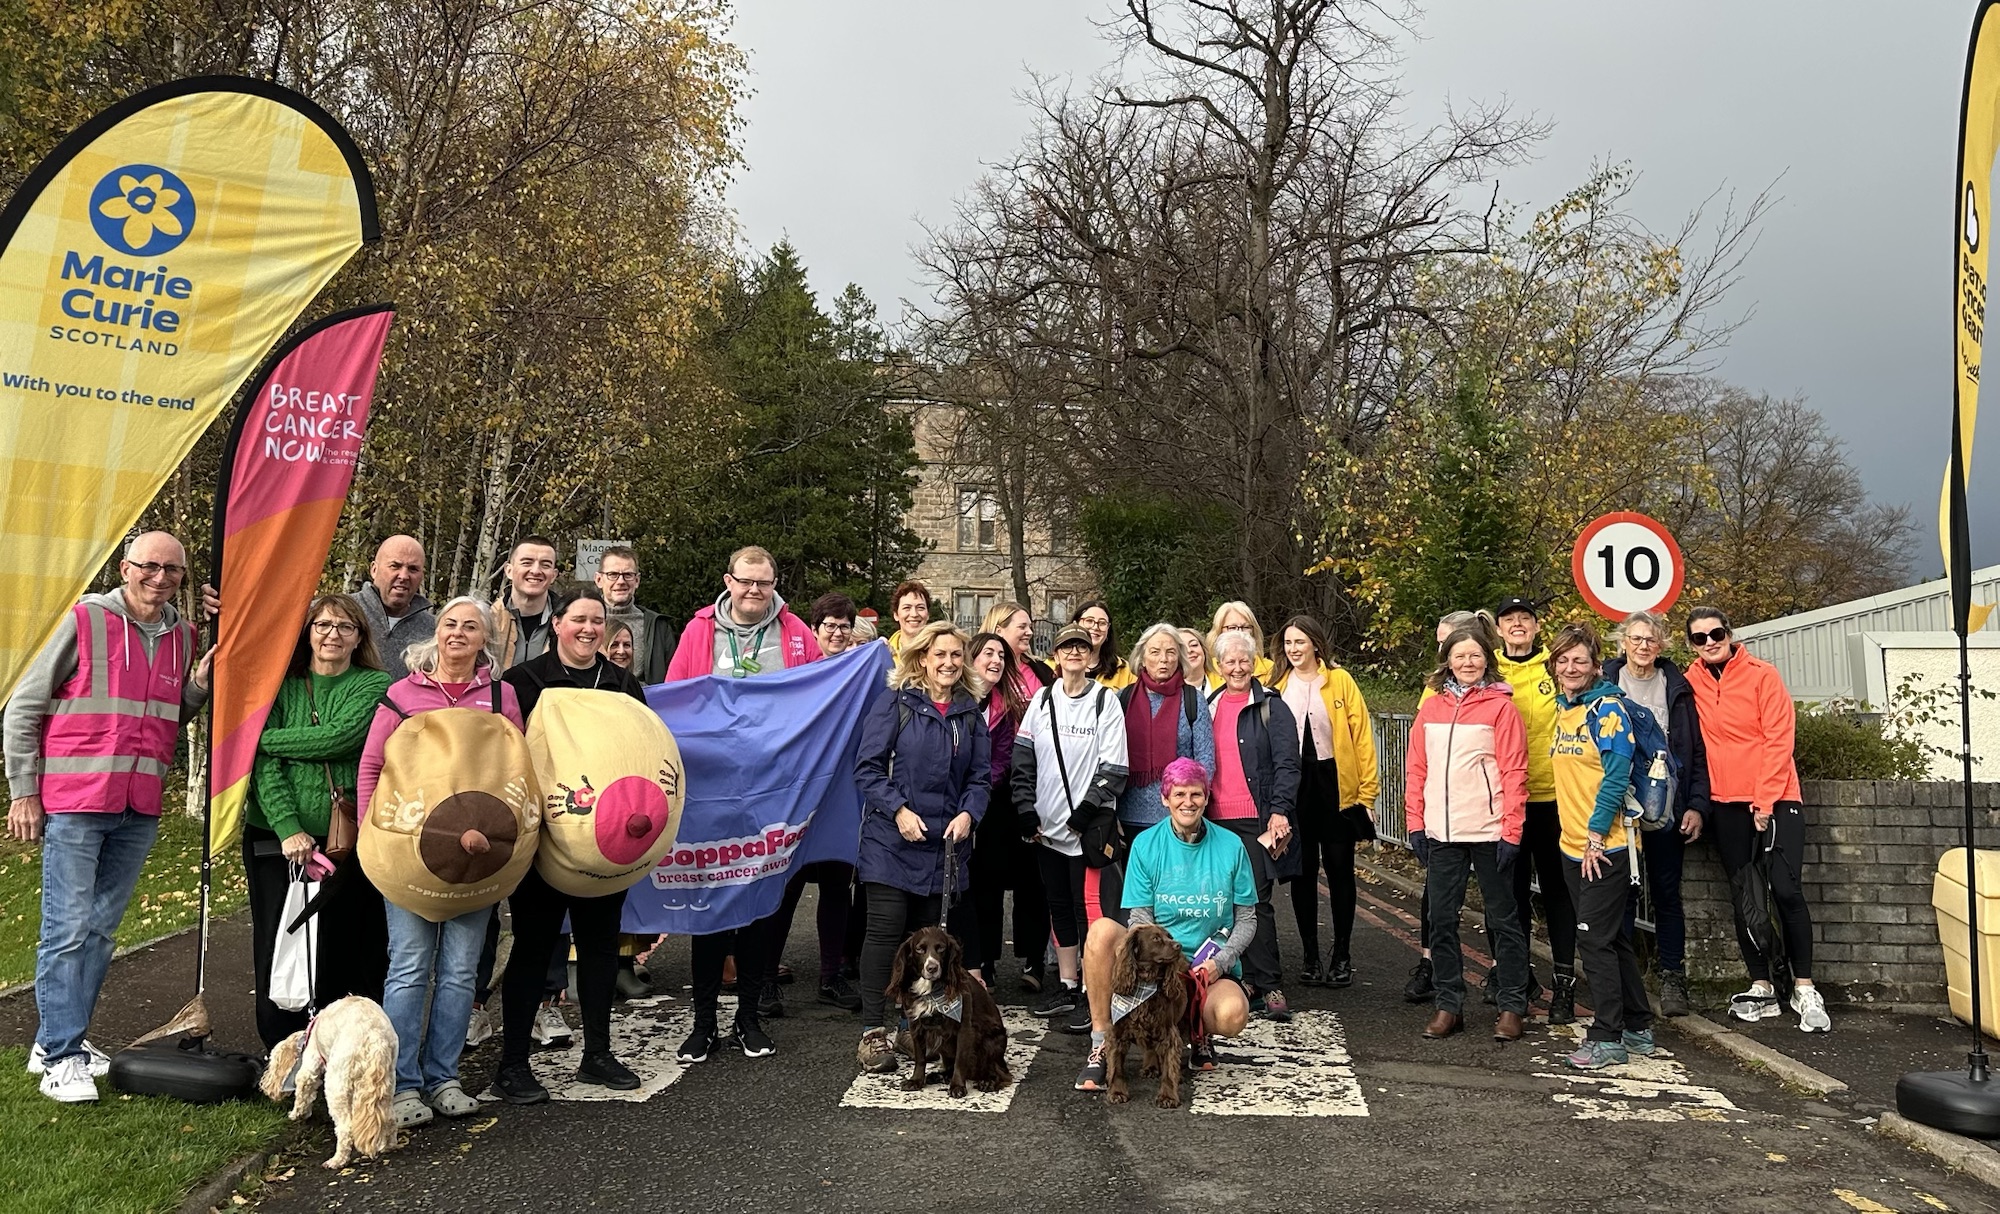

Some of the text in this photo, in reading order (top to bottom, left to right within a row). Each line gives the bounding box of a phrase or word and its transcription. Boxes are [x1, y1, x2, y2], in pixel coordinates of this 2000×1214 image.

[61, 251, 192, 299] Marie
[61, 288, 180, 333] Curie
[50, 326, 178, 356] SCOTLAND
[3, 372, 196, 411] With you to the end
[271, 383, 362, 416] BREAST
[265, 411, 362, 440] CANCER
[265, 436, 326, 463] NOW
[330, 458, 349, 466] care
[1597, 545, 1660, 590] 10
[1557, 744, 1583, 756] Curie
[1561, 732, 1588, 744] Marie
[656, 872, 704, 884] breast
[707, 866, 759, 882] cancer
[408, 884, 499, 899] coppafeel.org
[1156, 894, 1210, 905] TRACEYS
[1178, 908, 1211, 918] TREK
